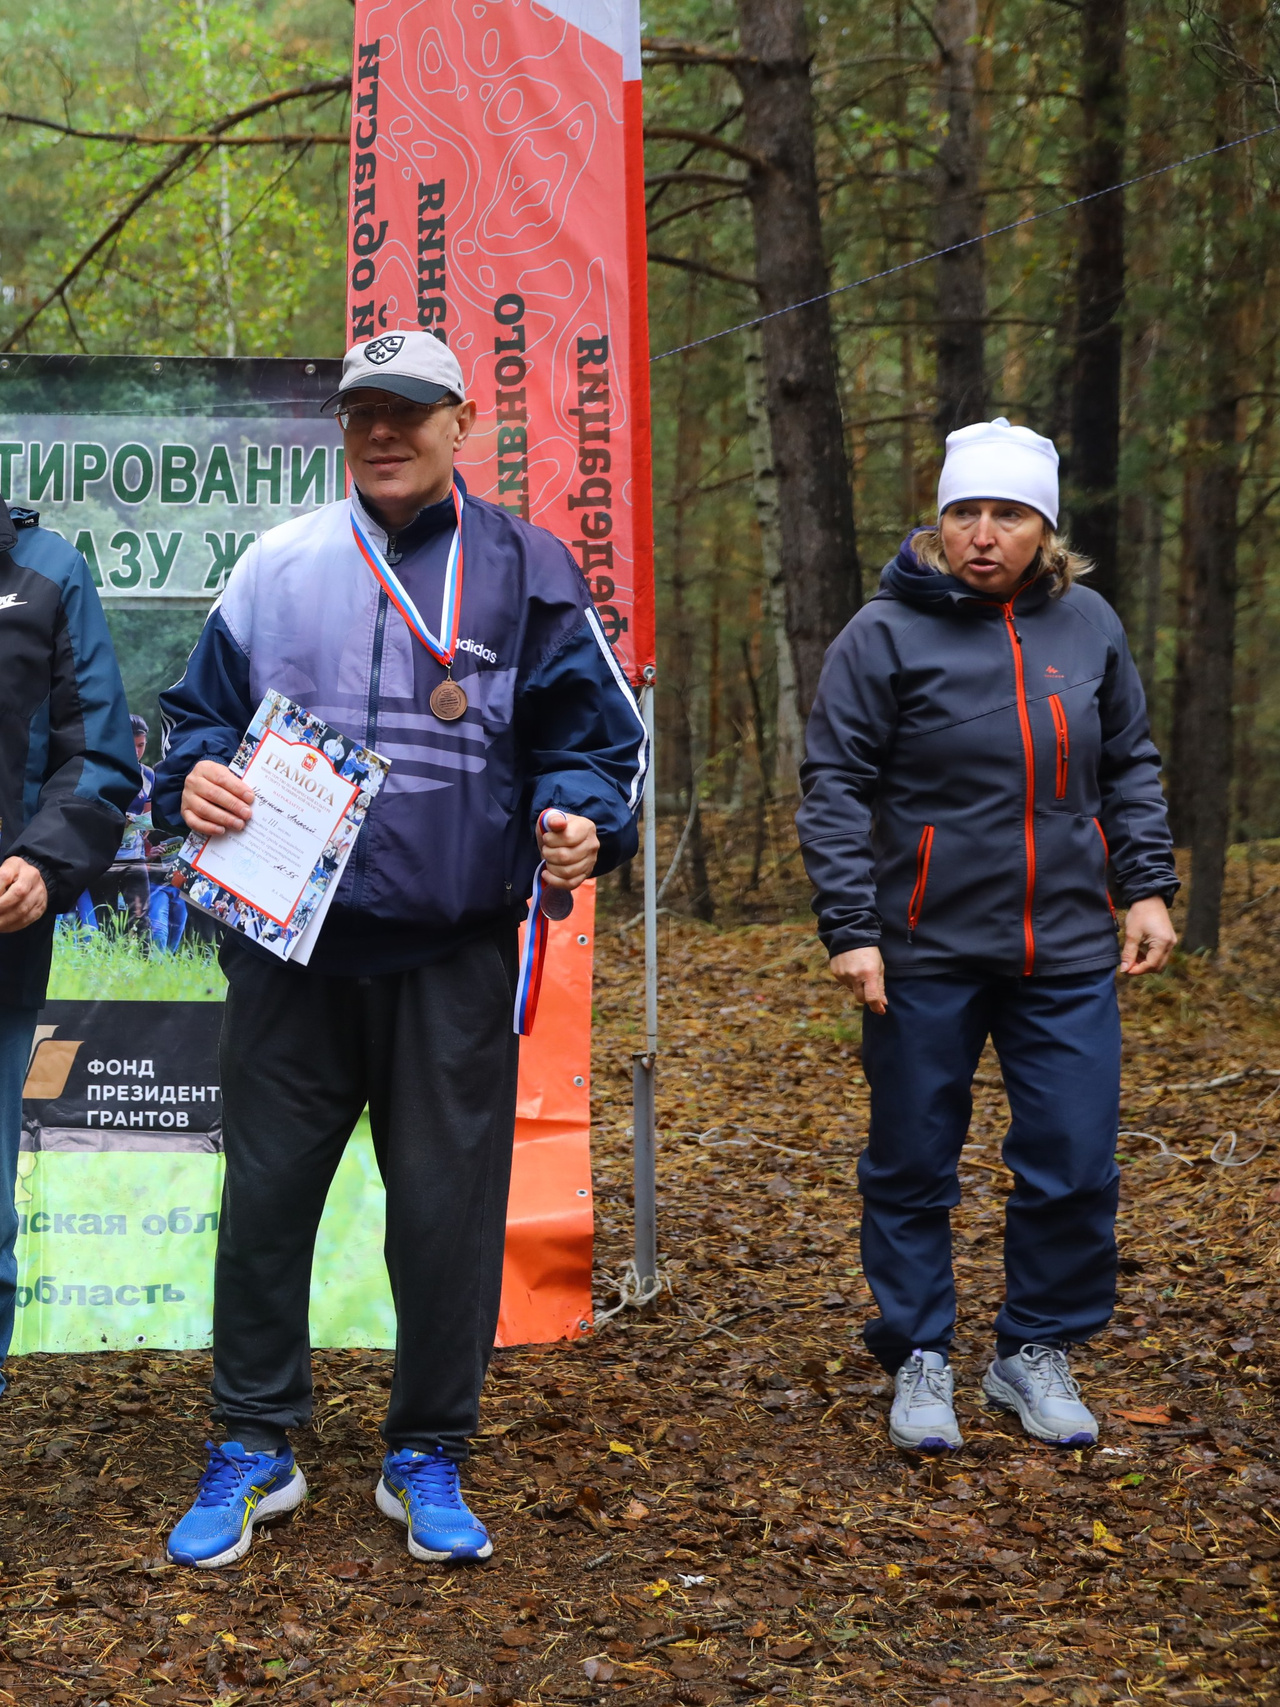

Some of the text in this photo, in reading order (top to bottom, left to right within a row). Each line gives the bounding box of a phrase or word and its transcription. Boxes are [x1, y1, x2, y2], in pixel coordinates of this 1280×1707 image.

[263, 751, 338, 806] ГРАМОТА
[87, 1058, 155, 1079] ФОНД
[87, 1085, 221, 1105] ПРЕЗИДЕНТ
[87, 1110, 190, 1128] ГРАНТОВ
